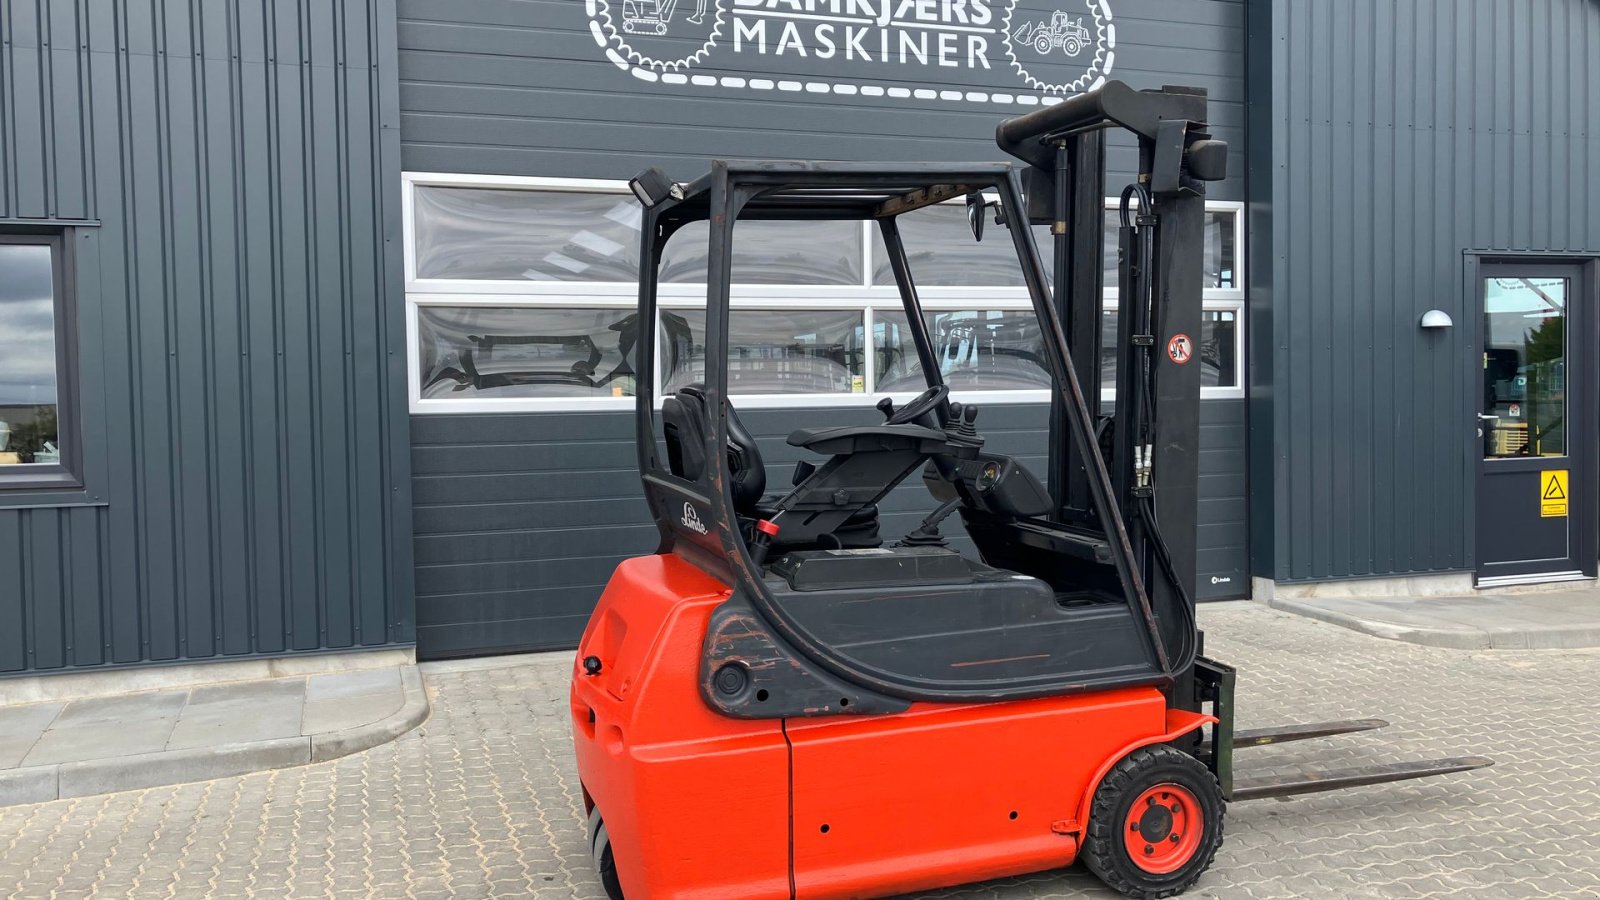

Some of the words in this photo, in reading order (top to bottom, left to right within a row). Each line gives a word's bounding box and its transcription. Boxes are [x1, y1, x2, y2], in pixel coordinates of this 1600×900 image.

[734, 0, 992, 26] JÆRS
[733, 17, 992, 69] MASKINER
[681, 501, 708, 535] Linde
